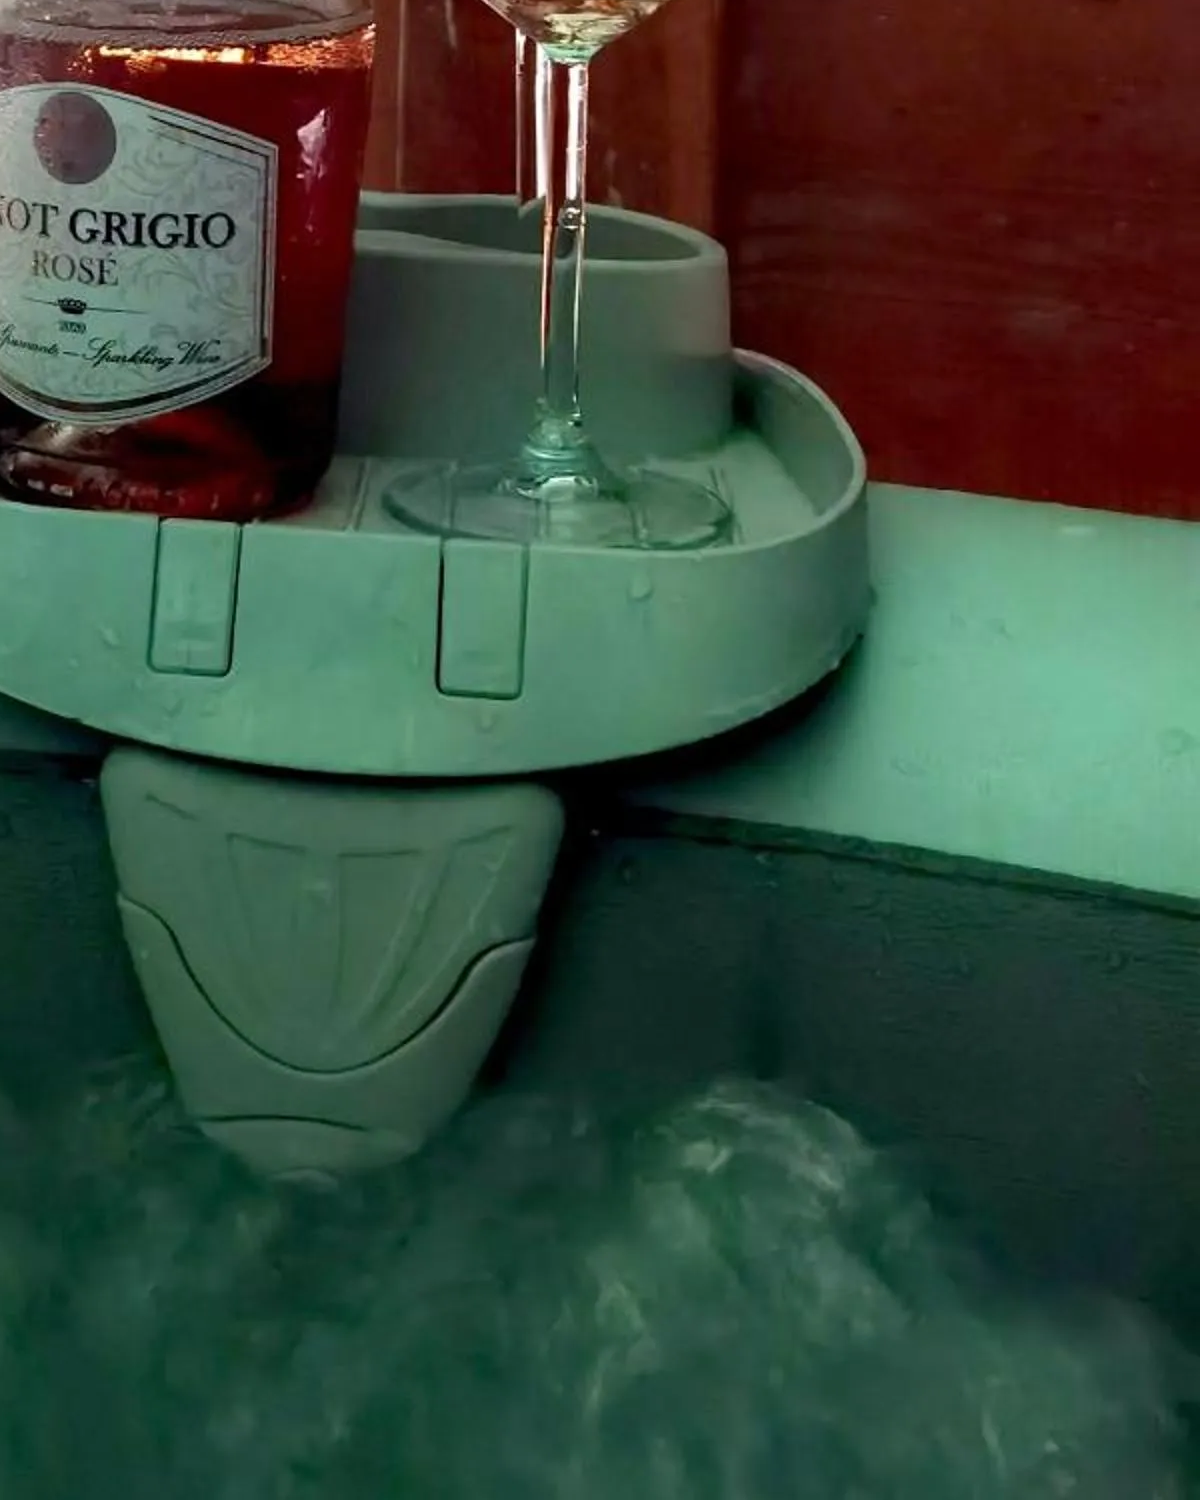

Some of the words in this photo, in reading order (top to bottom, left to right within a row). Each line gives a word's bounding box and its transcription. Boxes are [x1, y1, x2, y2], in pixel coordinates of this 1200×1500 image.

[68, 207, 237, 250] GRIGIO
[31, 249, 119, 287] ROSÉ
[82, 337, 174, 373] Sparkling
[177, 338, 221, 366] Wine
